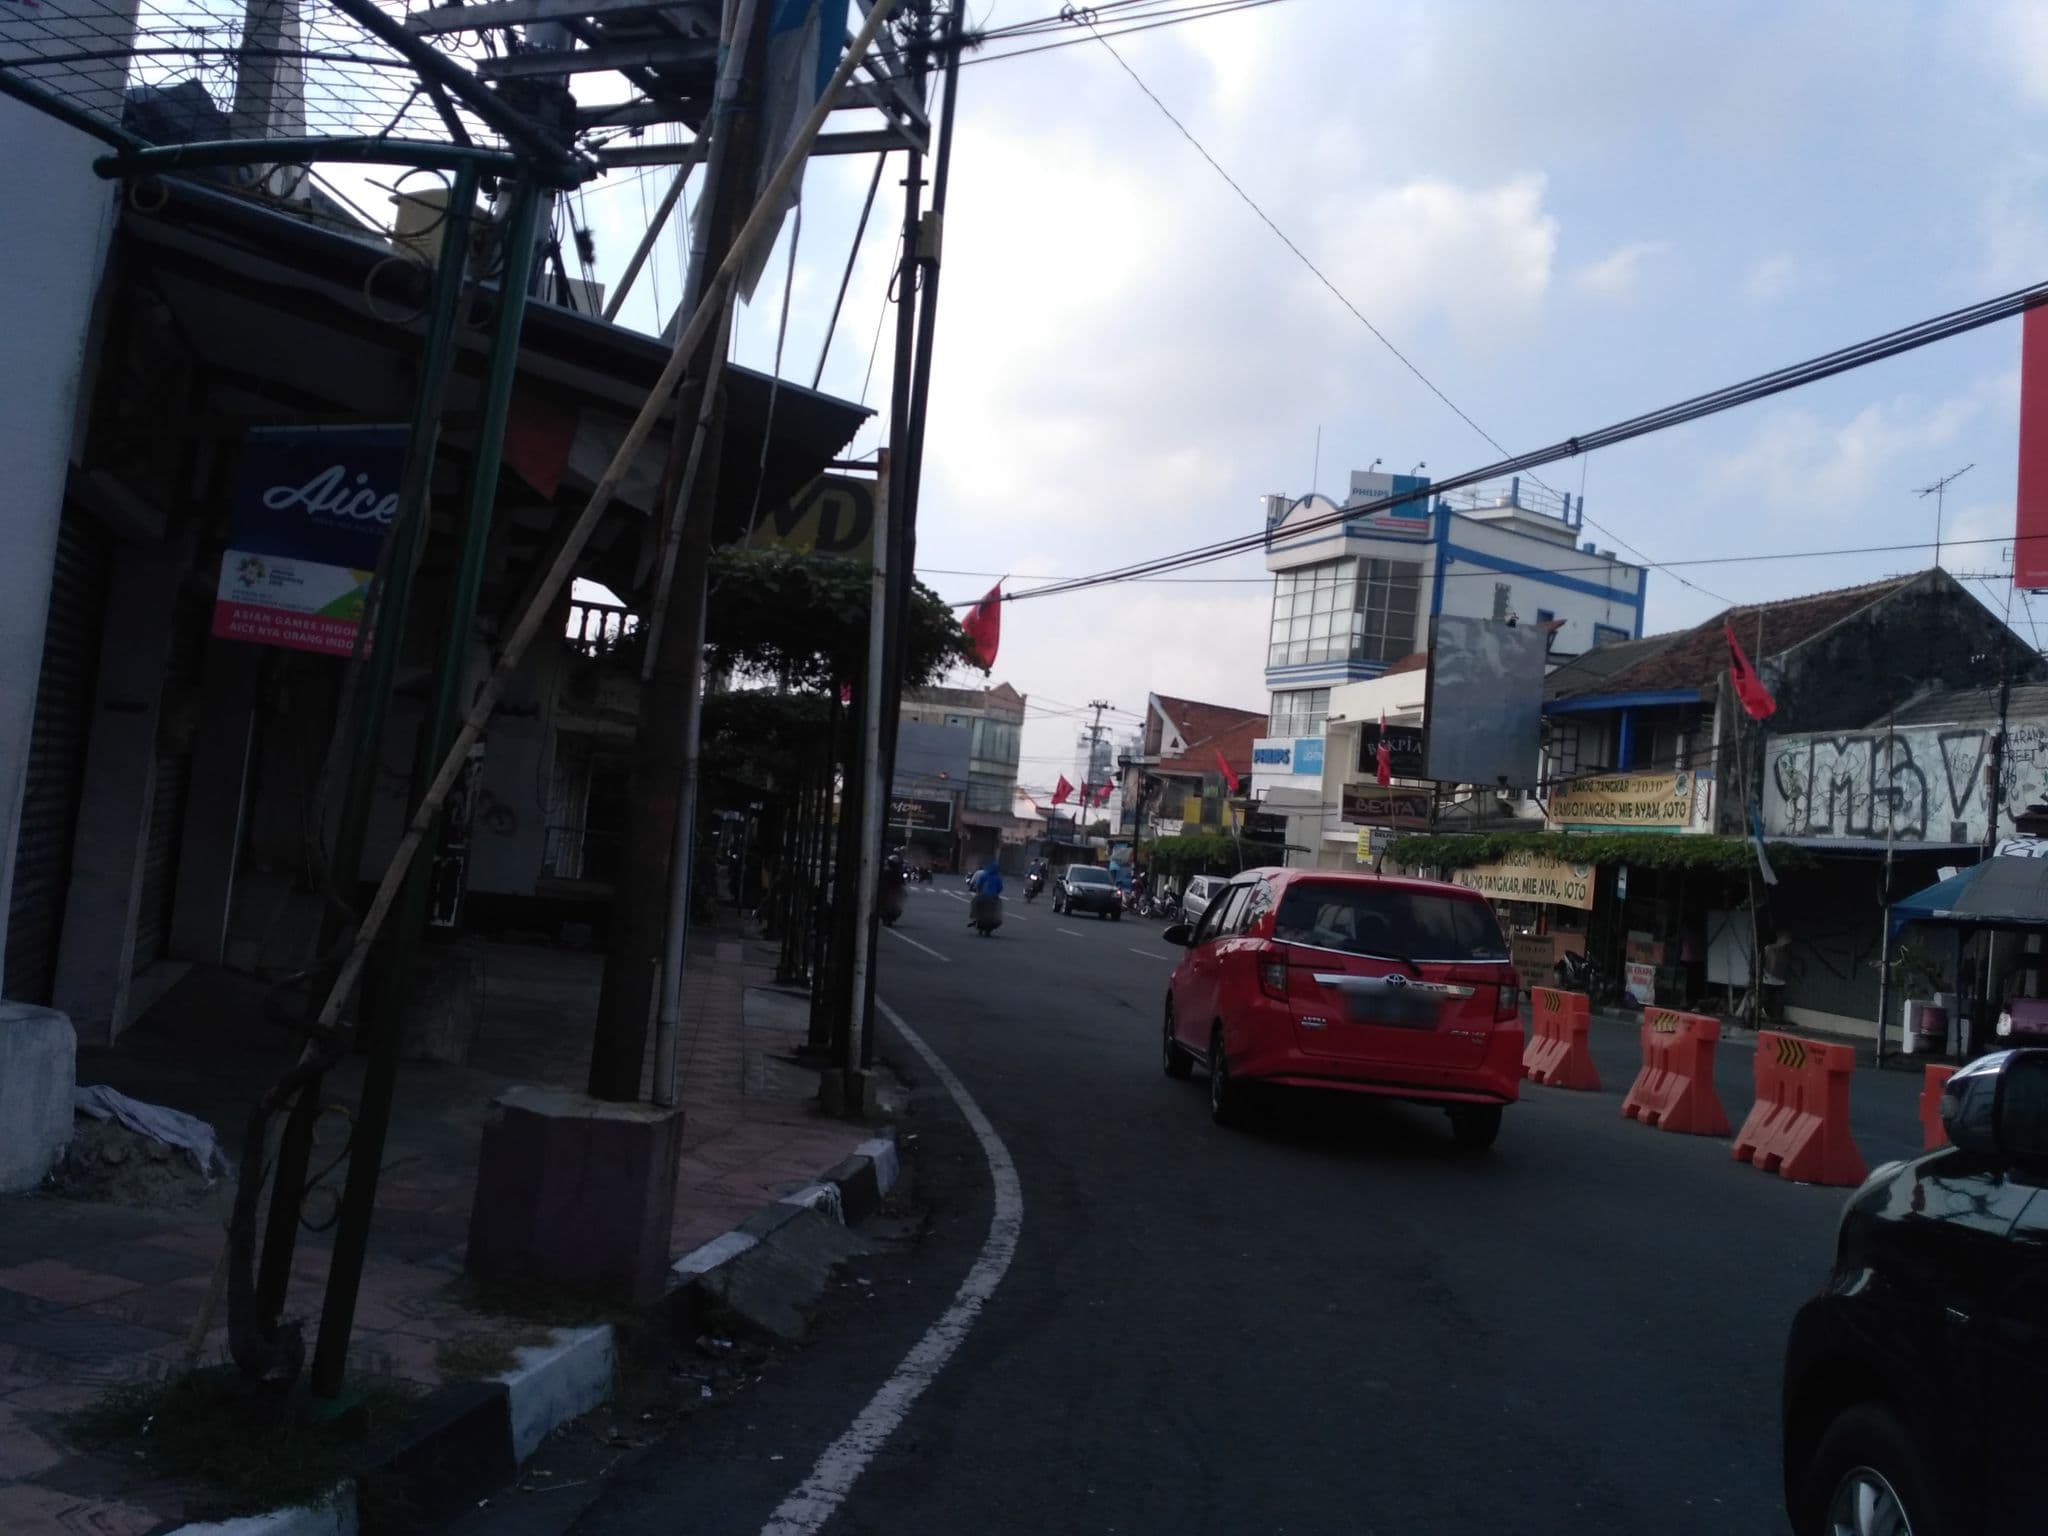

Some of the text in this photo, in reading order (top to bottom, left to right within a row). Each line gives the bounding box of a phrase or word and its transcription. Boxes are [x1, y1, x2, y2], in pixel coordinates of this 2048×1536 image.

[262, 464, 400, 524] Aice
[1352, 487, 1390, 498] PHILIPS
[231, 608, 272, 623] ASIAN
[274, 614, 317, 631] GAMES
[229, 621, 255, 634] AICE
[257, 625, 280, 638] NYA
[283, 629, 322, 646] ORANG
[1367, 736, 1423, 757] BKPIA
[1254, 748, 1290, 765] PHILIPS
[1355, 799, 1416, 817] BETTA
[1618, 801, 1633, 818] MIE
[1662, 801, 1687, 819] SOTO
[1521, 877, 1538, 894] MIE
